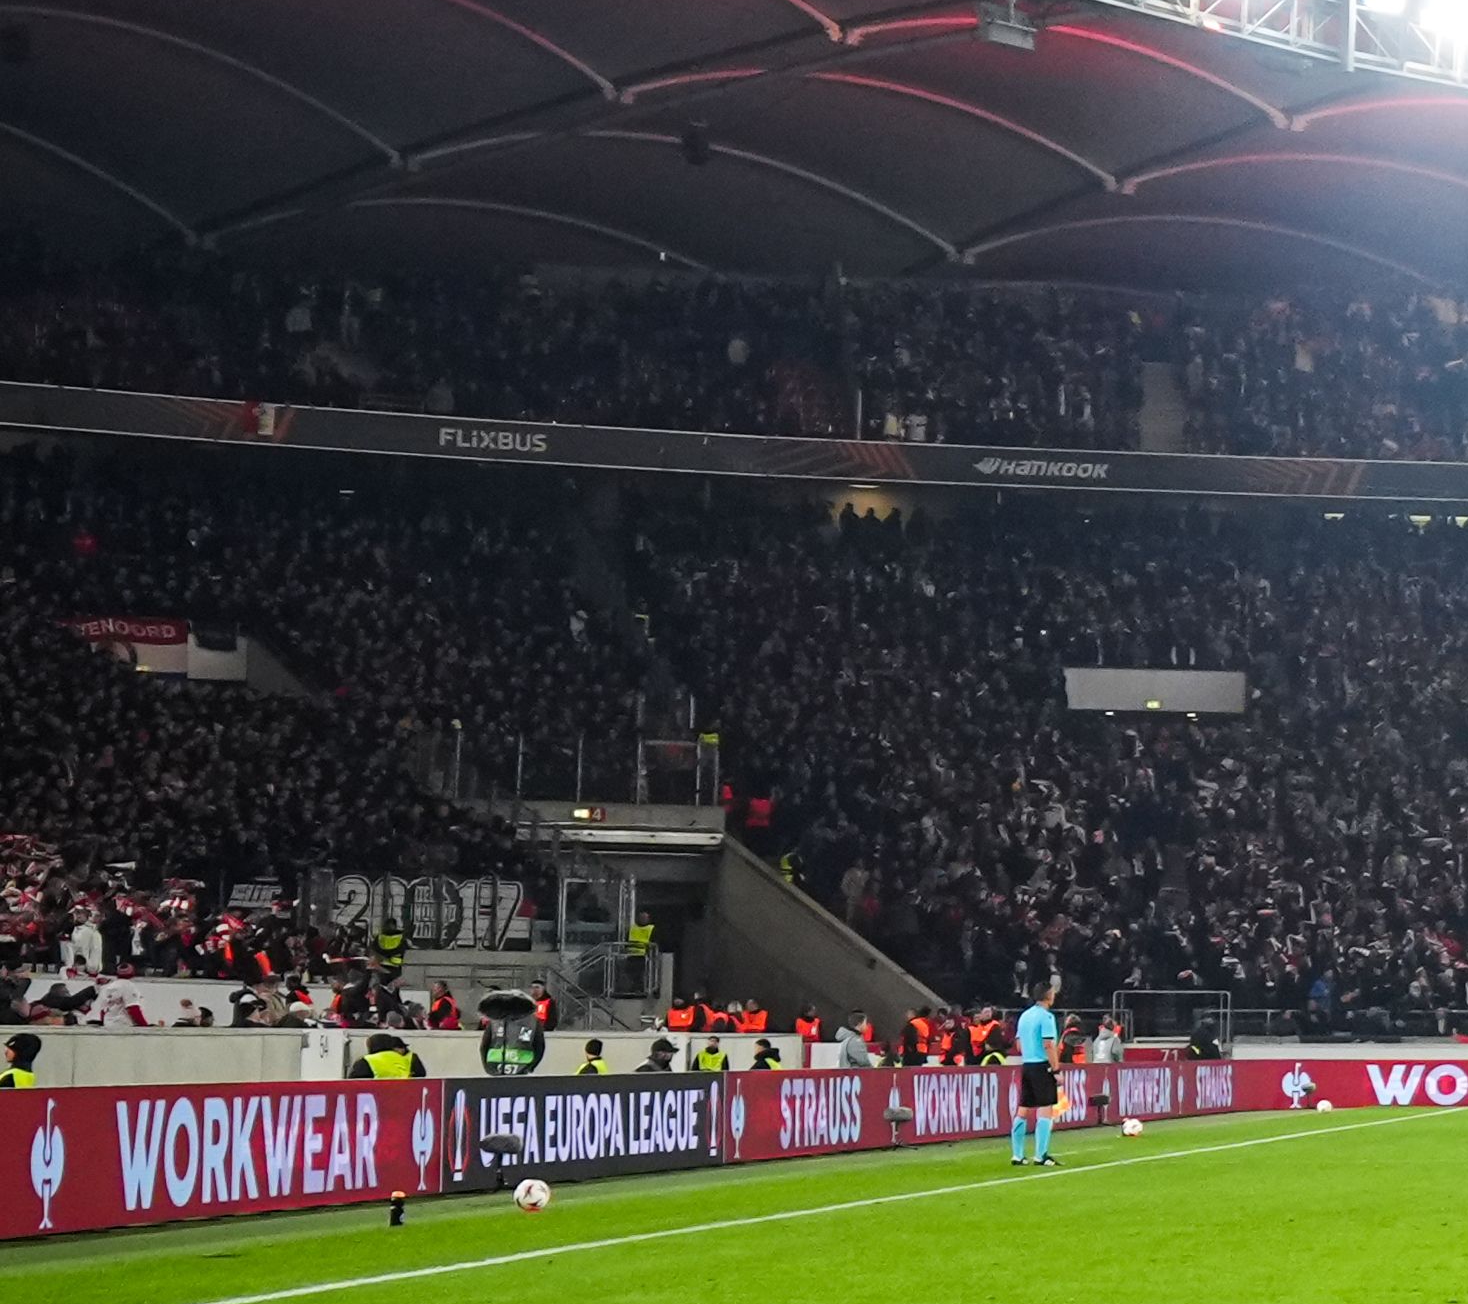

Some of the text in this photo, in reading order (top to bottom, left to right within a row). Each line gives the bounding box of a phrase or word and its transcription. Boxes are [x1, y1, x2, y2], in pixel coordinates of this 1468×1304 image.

[1160, 1049, 1178, 1062] 71
[1196, 1064, 1232, 1110] STRAUSS
[779, 1075, 861, 1150] STRAUSS
[913, 1072, 998, 1136] WORKWEAR
[1117, 1067, 1171, 1116] WORKWEAR
[116, 1092, 378, 1211] WORKWEAR
[544, 1091, 625, 1163] EUROPA
[628, 1088, 699, 1155] LEAGUE
